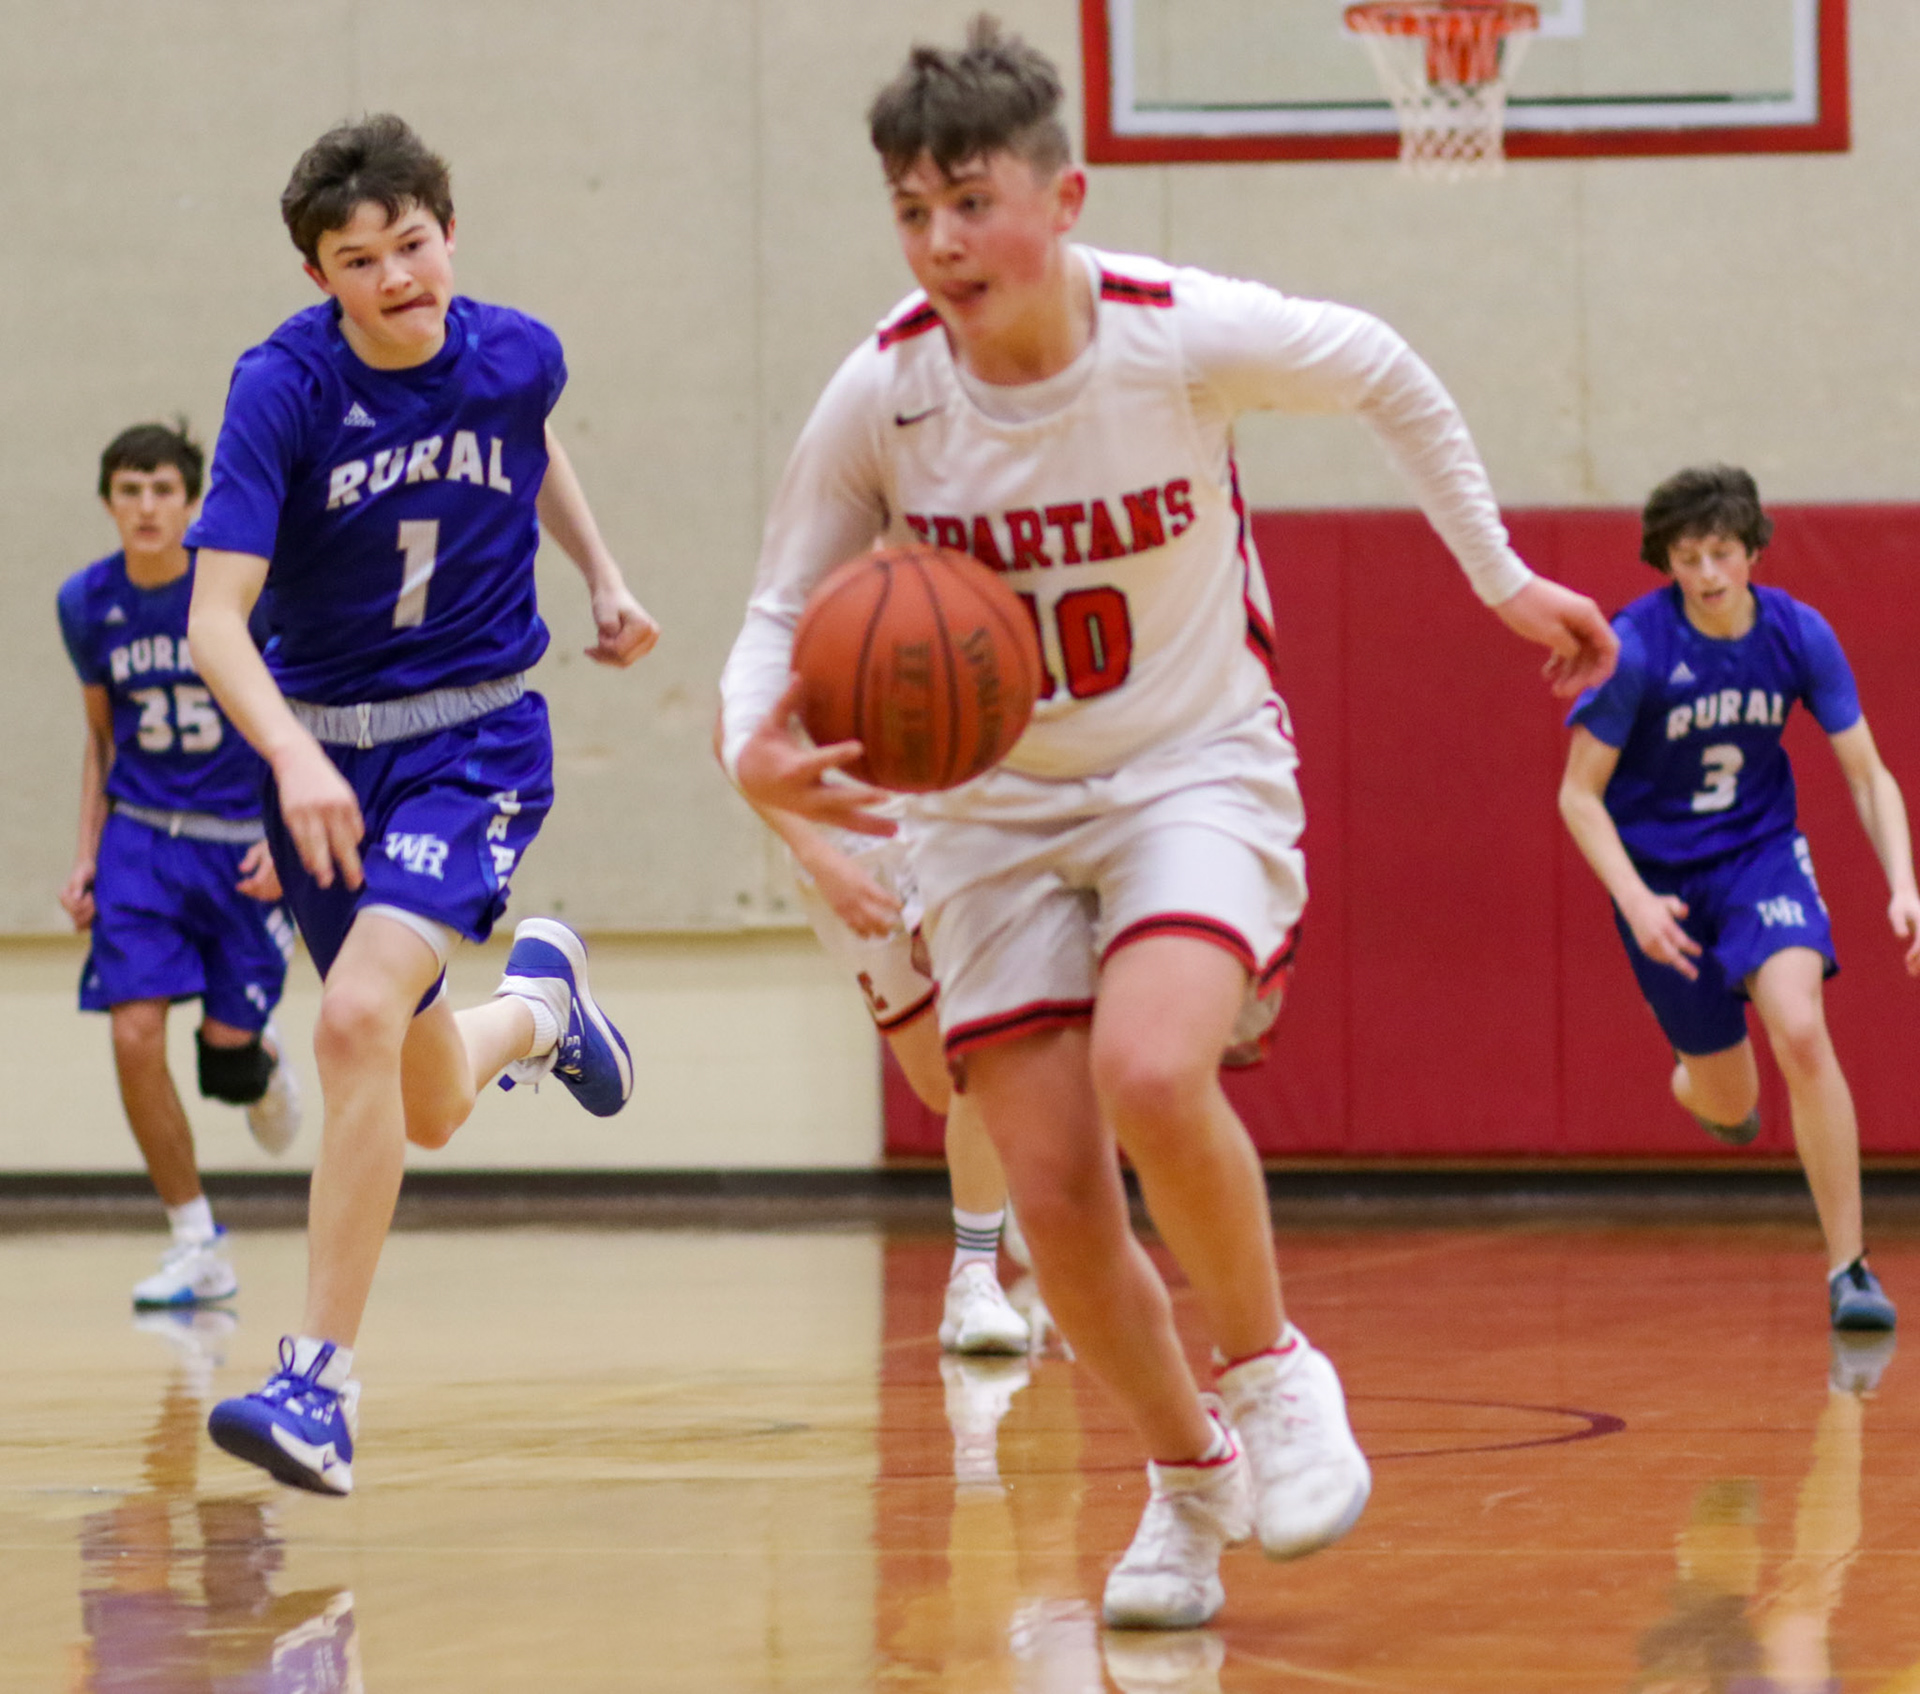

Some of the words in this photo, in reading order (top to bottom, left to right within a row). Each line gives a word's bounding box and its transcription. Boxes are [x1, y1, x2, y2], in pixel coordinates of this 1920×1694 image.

[326, 429, 512, 511] RURAL
[392, 518, 440, 629] 1
[131, 686, 223, 753] 35
[1691, 743, 1745, 813] 3
[385, 832, 449, 881] WR
